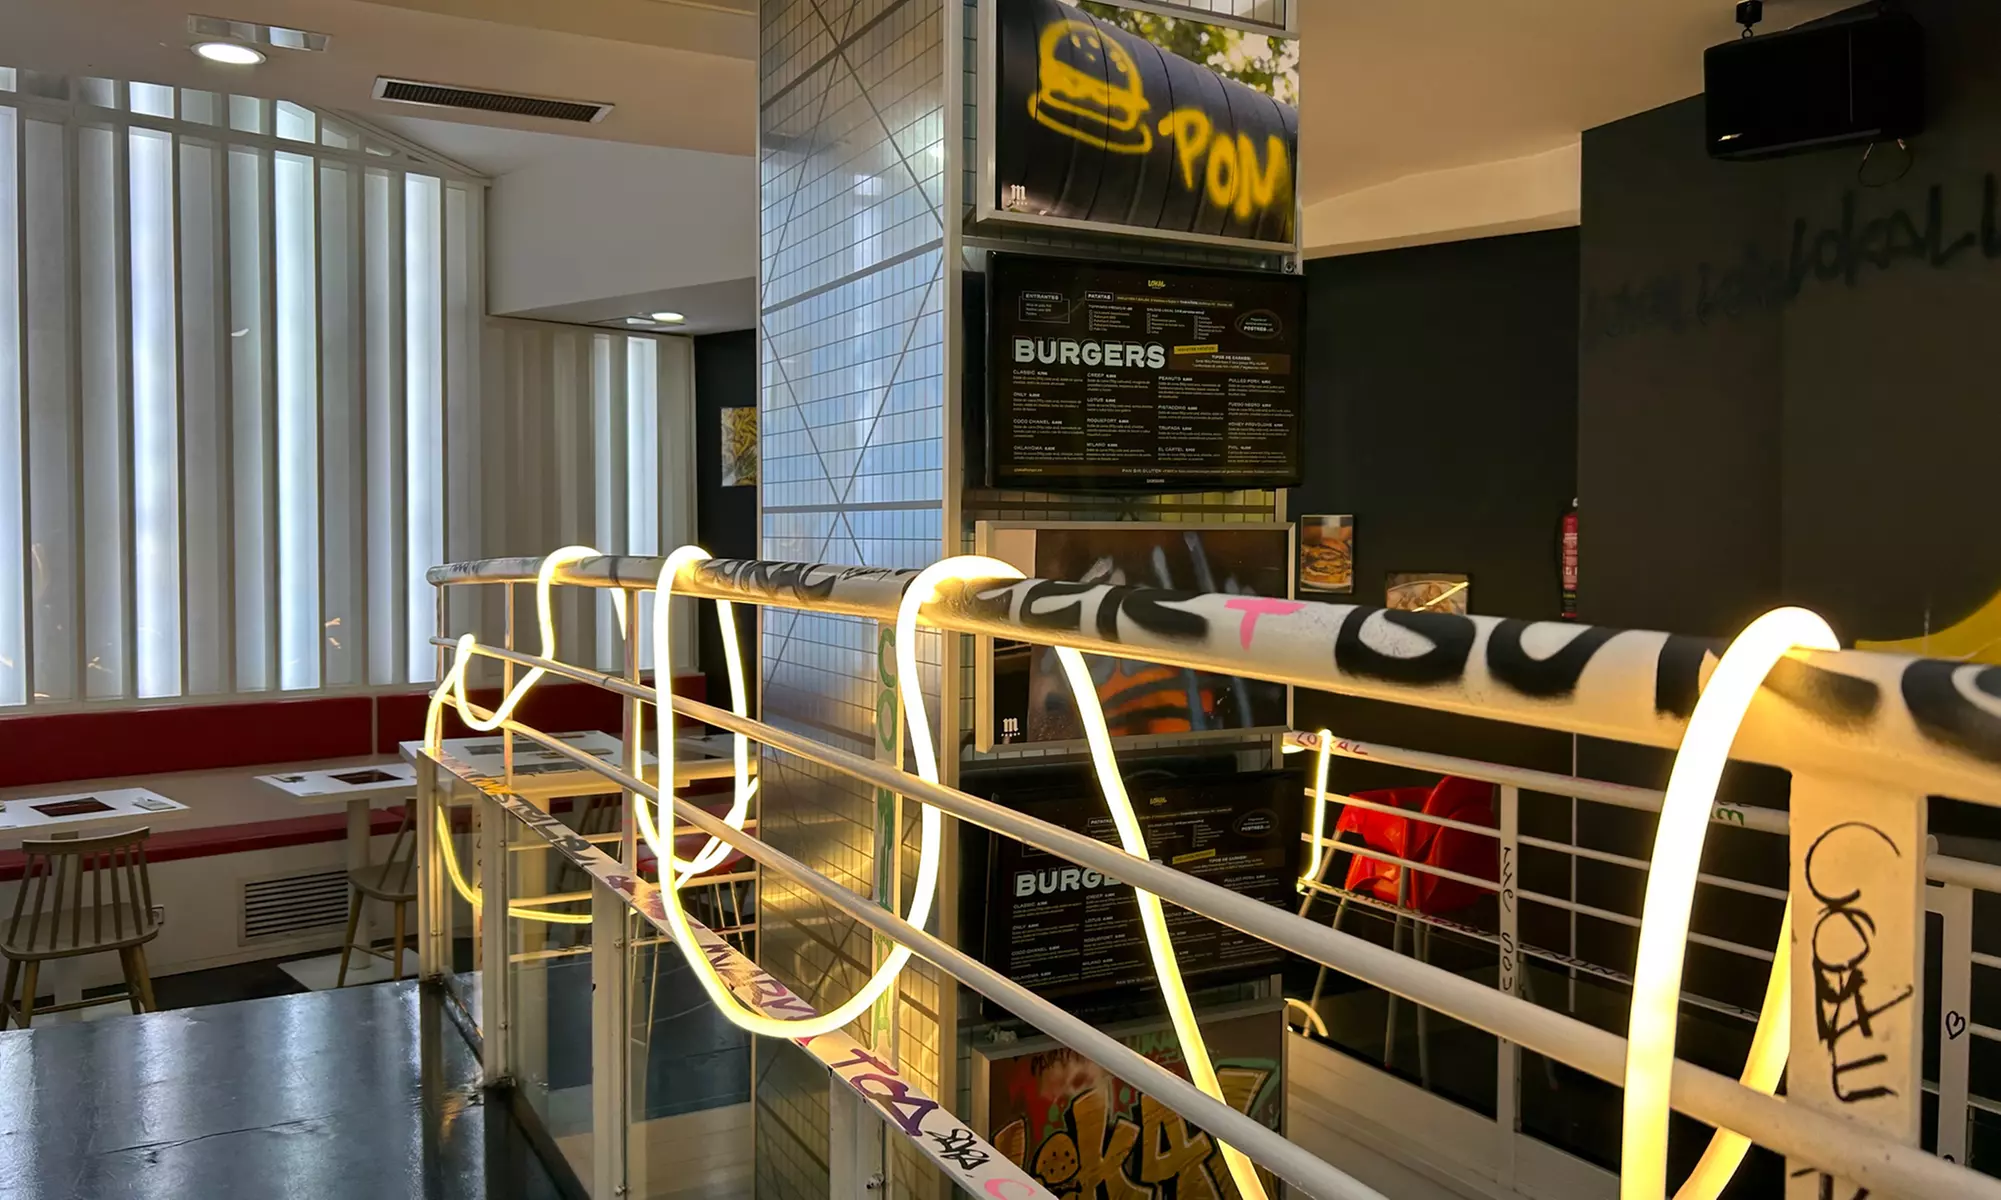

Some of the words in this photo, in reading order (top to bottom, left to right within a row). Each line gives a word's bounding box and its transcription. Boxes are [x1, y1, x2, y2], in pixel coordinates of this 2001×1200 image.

[1158, 108, 1288, 220] PON
[1025, 293, 1060, 301] ENTRANTES
[1087, 293, 1111, 301] PATATAS
[1014, 339, 1166, 369] BURGERS
[1297, 732, 1367, 756] LOAL
[1016, 866, 1122, 897] BURGE
